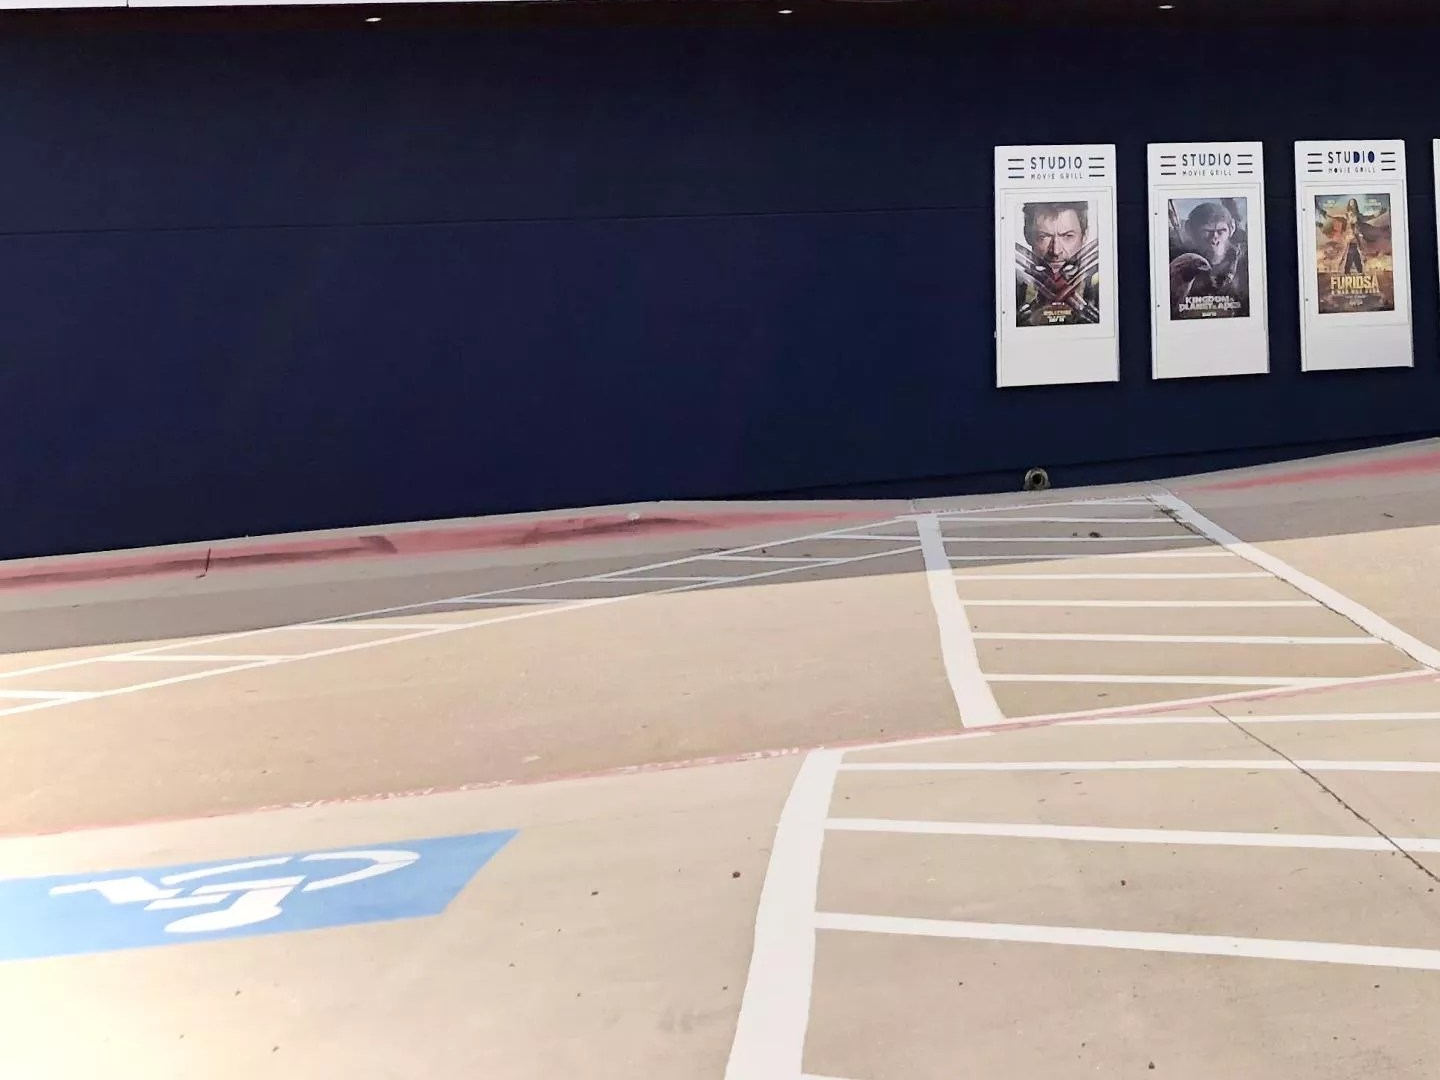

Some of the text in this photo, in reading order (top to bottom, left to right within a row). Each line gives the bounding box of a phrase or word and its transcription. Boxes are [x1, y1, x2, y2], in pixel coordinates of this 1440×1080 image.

[1030, 156, 1083, 170] STUDIO
[1182, 152, 1231, 166] STUDIO
[1328, 150, 1375, 163] STUDIO
[1031, 172, 1083, 180] MOVIE GRILL
[1182, 169, 1207, 177] MOVIE
[1330, 274, 1379, 290] FURIOSA
